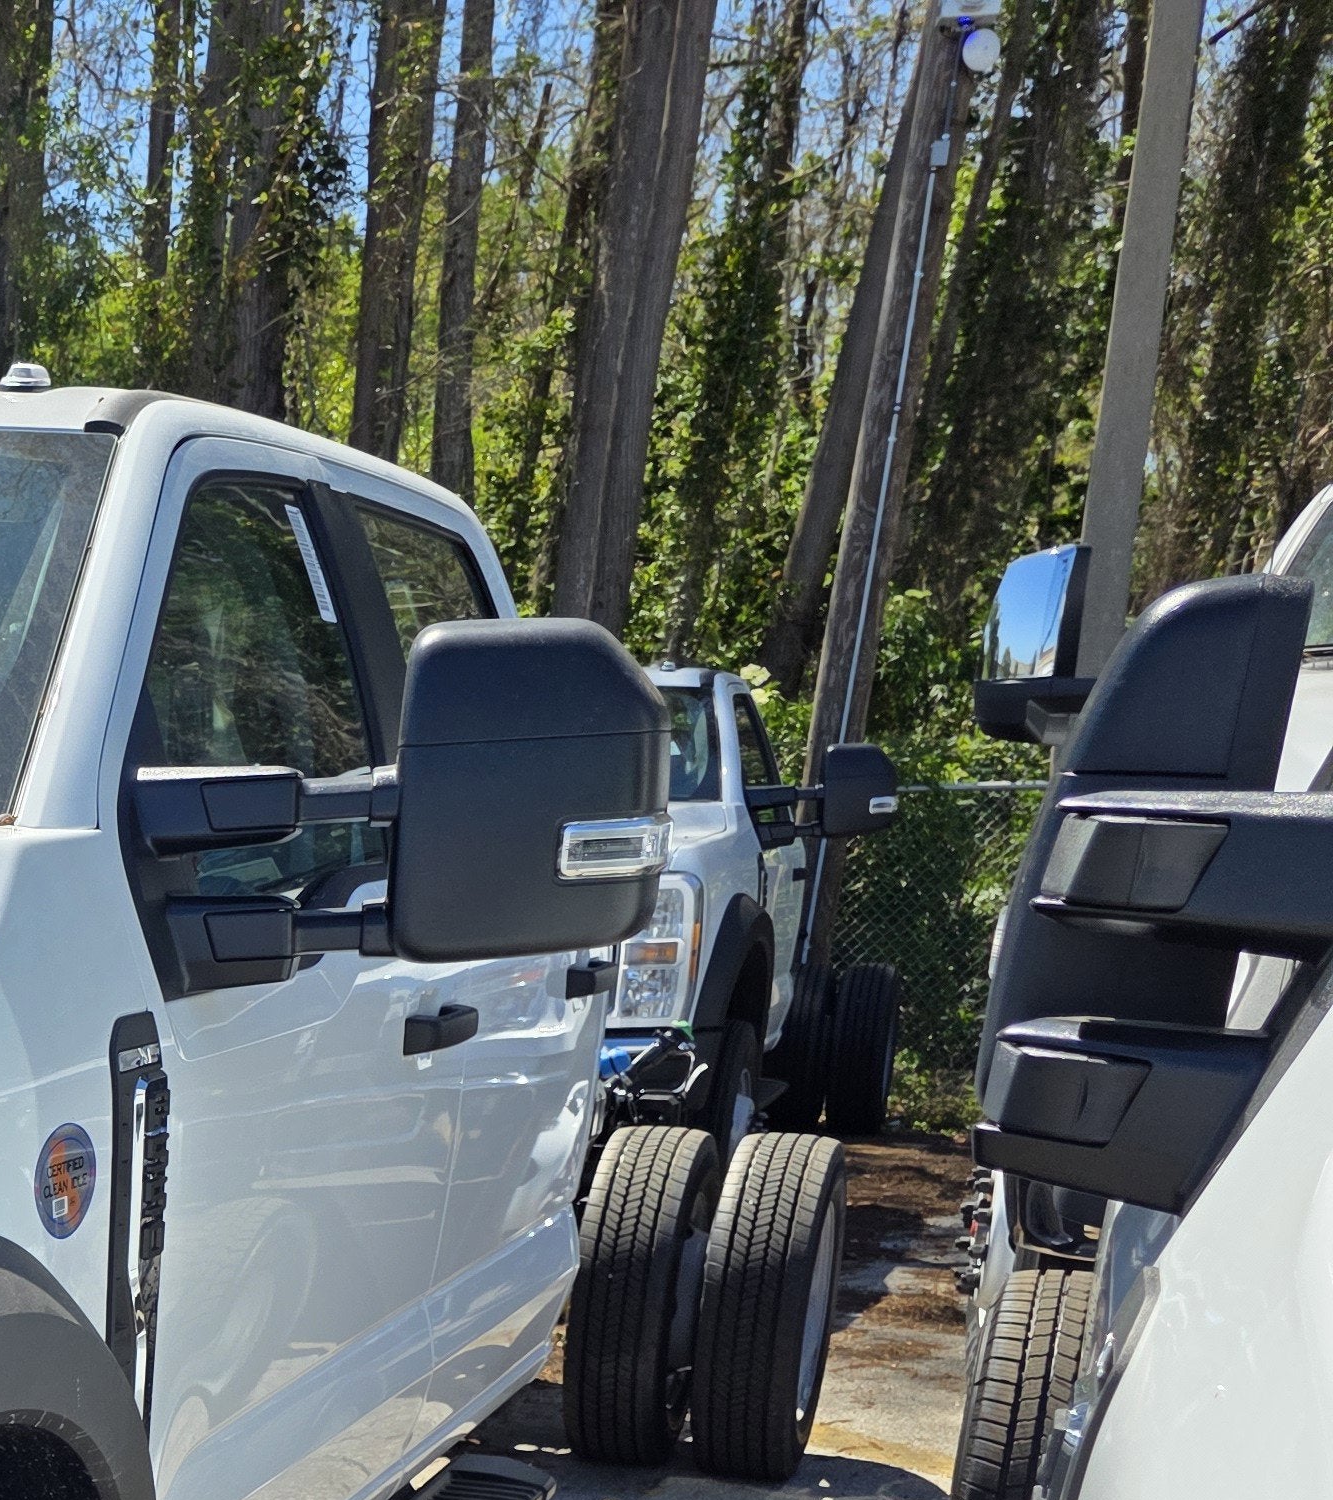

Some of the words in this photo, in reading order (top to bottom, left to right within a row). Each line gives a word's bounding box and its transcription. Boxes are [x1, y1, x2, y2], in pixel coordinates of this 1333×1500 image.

[46, 1156, 85, 1179] CERTIFIED
[43, 1180, 69, 1199] CLEAN
[71, 1173, 88, 1190] IDLE
